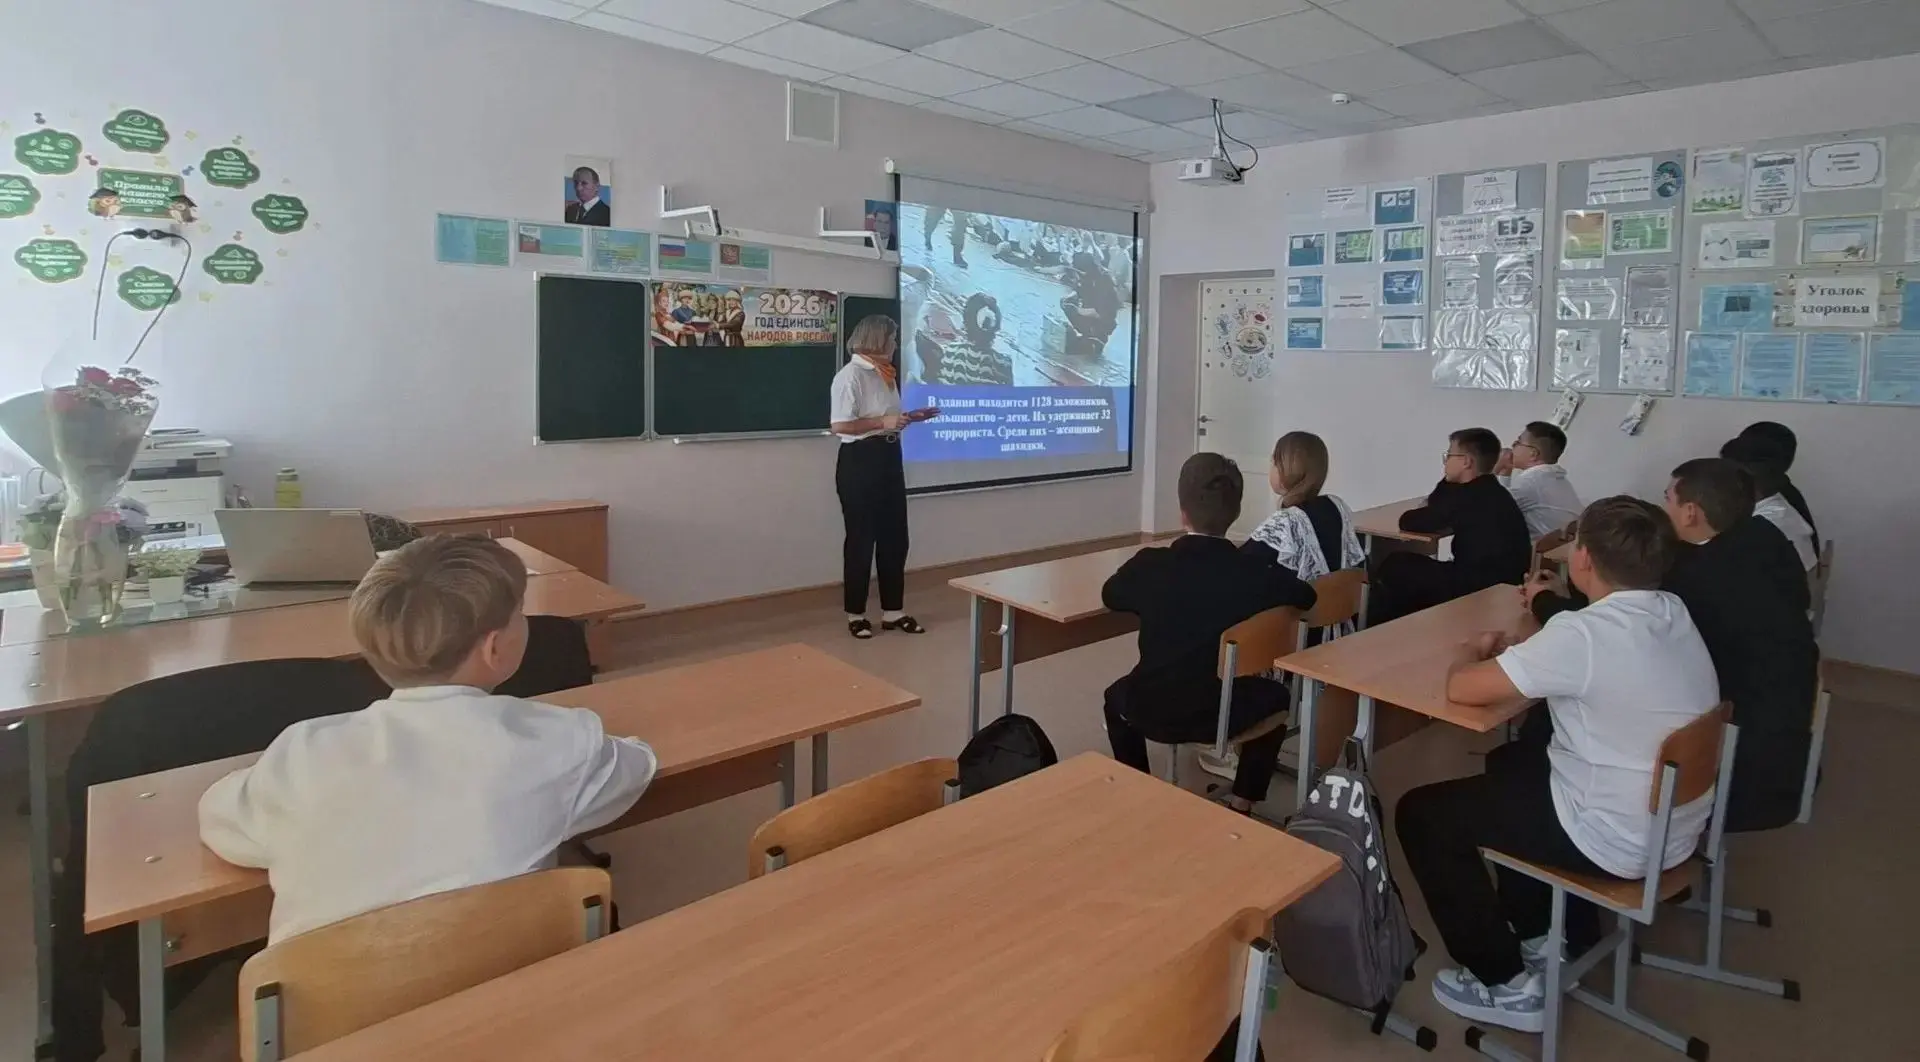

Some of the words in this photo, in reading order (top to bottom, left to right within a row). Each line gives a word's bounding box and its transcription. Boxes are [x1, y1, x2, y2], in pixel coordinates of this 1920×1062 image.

[1498, 217, 1534, 236] ЕГЭ
[1808, 285, 1866, 296] Уголок
[759, 292, 821, 315] 2026
[755, 317, 774, 329] ГОД
[777, 317, 825, 329] ЕДИНСТВА
[748, 331, 793, 342] НАРОДОВ
[796, 332, 833, 342] РОССИИ
[927, 396, 936, 407] В
[938, 399, 975, 408] здании
[978, 399, 1028, 408] находится
[1031, 397, 1051, 407] 1128
[925, 414, 996, 423] ольшинство
[1006, 415, 1031, 424] дети.
[1032, 411, 1046, 421] Их
[1100, 409, 1111, 420] 32
[933, 429, 996, 440] террориста.
[997, 426, 1029, 439] Среди
[1029, 428, 1047, 437] них
